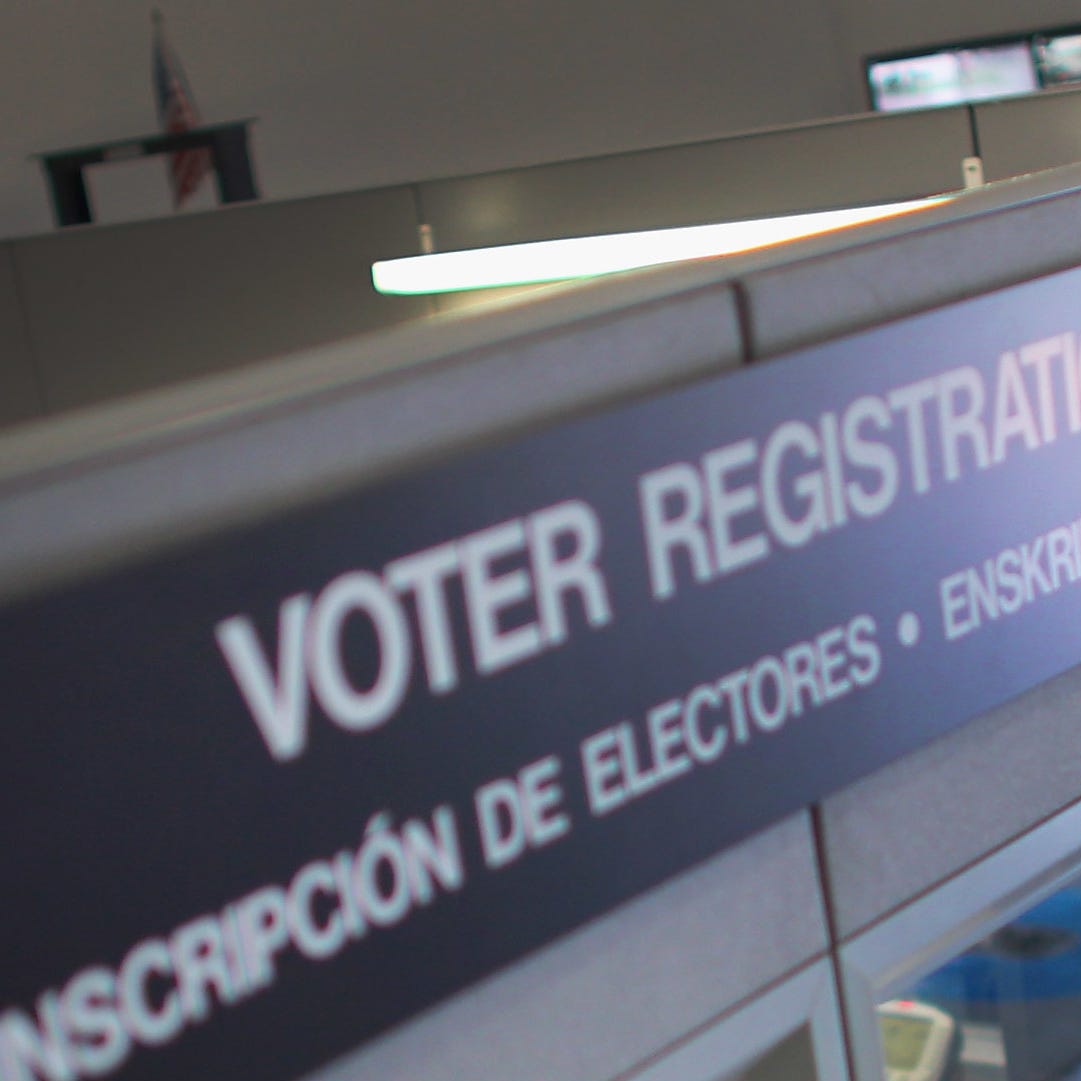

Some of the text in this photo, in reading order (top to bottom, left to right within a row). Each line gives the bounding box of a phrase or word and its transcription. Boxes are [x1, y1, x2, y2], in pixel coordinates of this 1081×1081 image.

[216, 500, 610, 761] VOTER
[474, 756, 570, 868] DE
[581, 615, 880, 815] ELECTORES
